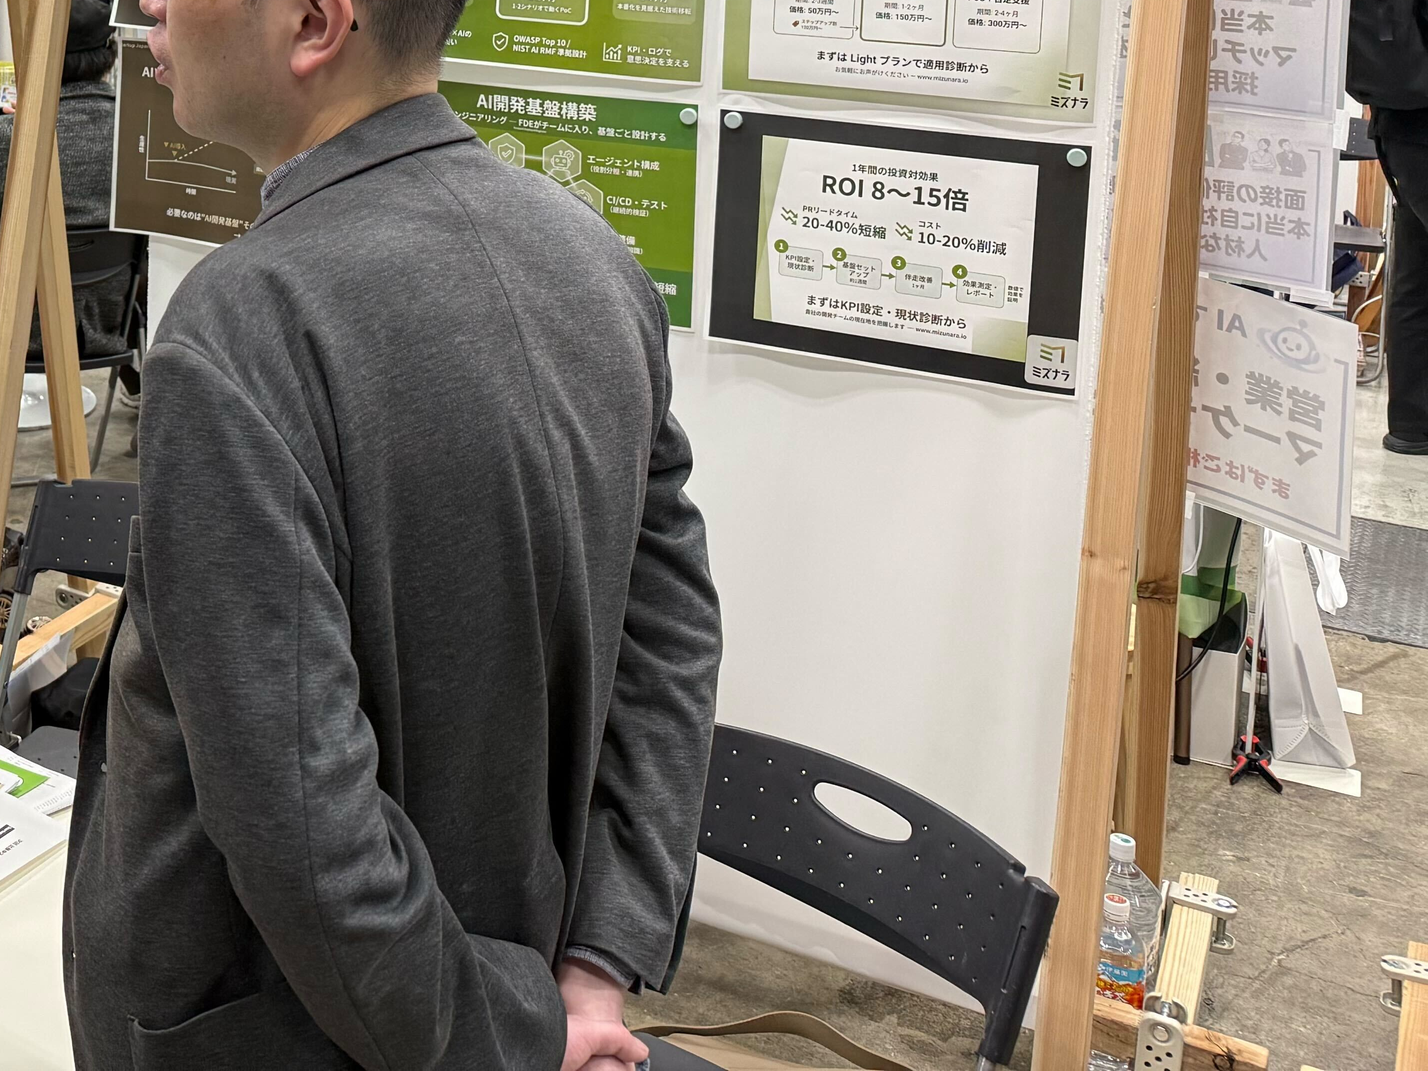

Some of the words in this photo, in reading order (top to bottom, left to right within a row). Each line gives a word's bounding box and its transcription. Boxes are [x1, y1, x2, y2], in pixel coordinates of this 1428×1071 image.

[514, 35, 540, 44] OWASP
[557, 39, 566, 47] 10
[540, 47, 556, 55] RMF
[816, 51, 847, 62] まずは
[850, 52, 877, 66] Light
[476, 94, 597, 122] AI開発基盤構築
[1050, 96, 1089, 109] ミズナラ
[587, 155, 660, 171] エージェント構成
[851, 163, 939, 184] 1年間の投資対効果
[822, 174, 864, 198] ROI
[802, 204, 858, 219] PRリードタイム
[802, 215, 887, 240] 20-40%短縮
[918, 220, 942, 230] コスト
[917, 232, 1007, 256] 10-20%削減
[1031, 365, 1070, 382] ミズナラ
